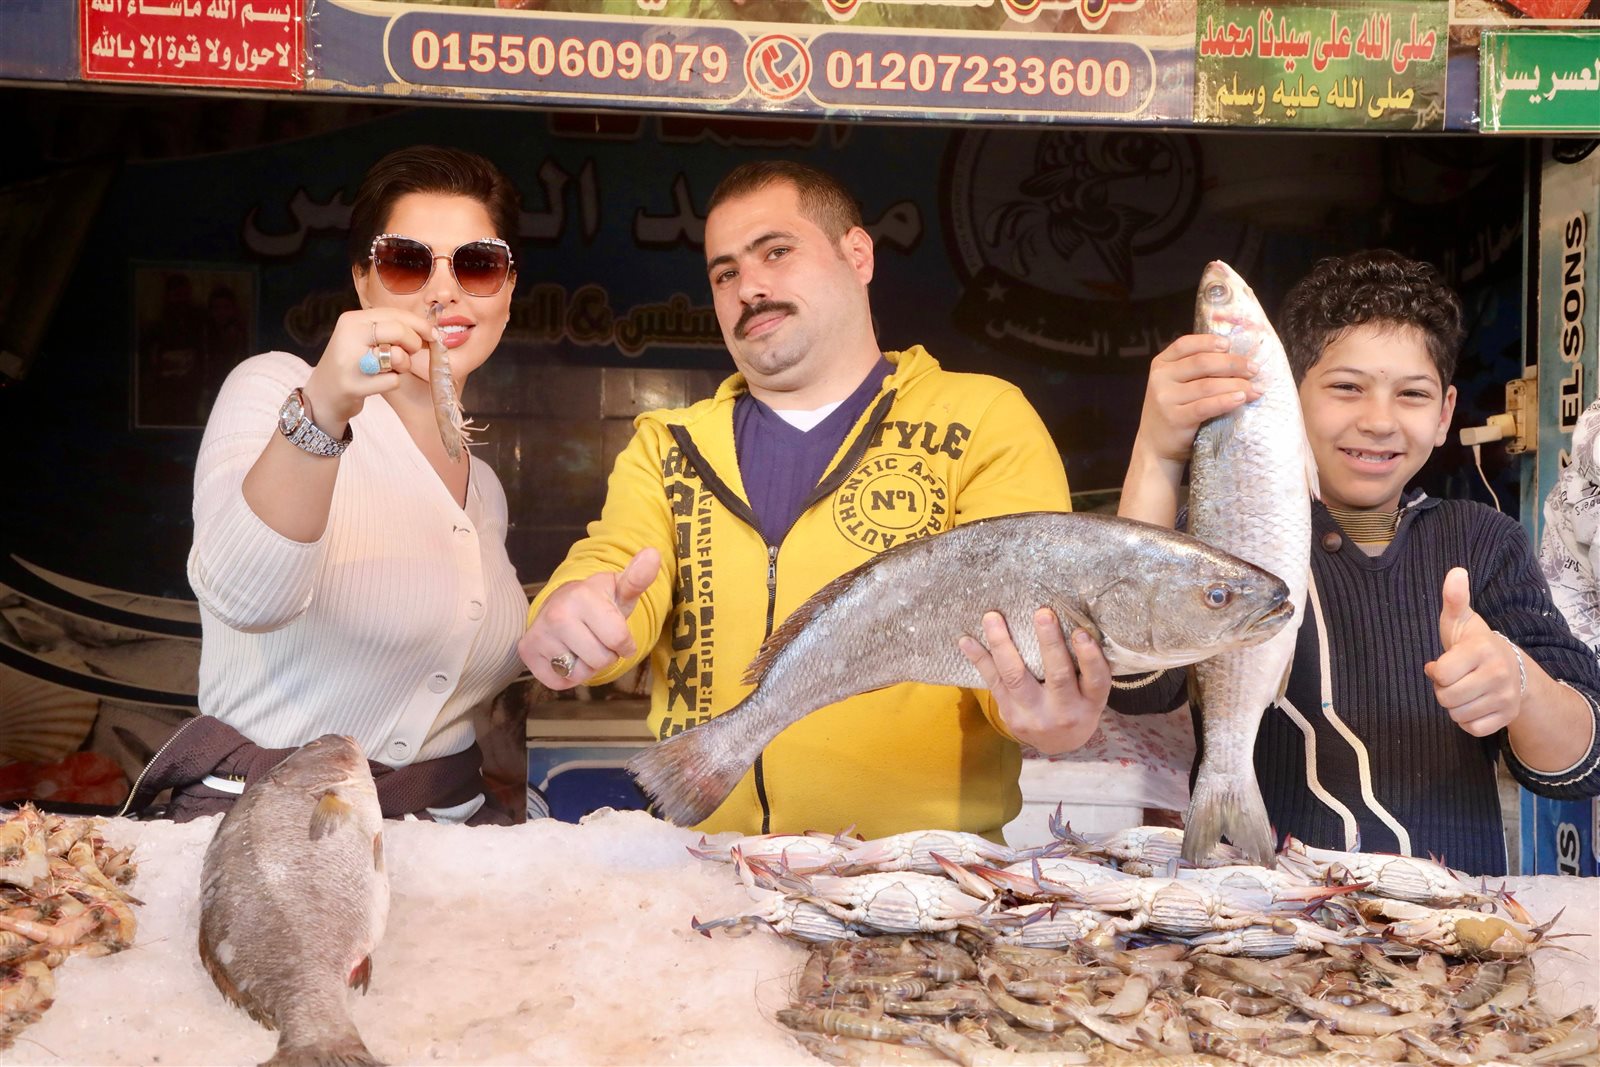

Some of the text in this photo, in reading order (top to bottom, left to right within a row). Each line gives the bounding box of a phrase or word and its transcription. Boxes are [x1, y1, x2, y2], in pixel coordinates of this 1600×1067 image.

[240, 3, 291, 32] بسم
[1200, 15, 1256, 58] محمد
[1257, 8, 1312, 72] سيدنا
[1312, 11, 1353, 72] على
[1355, 12, 1391, 61] الله
[91, 26, 136, 68] بالله
[165, 34, 201, 68] قوة
[205, 36, 231, 70] ولا
[411, 29, 729, 84] 01550609079
[1392, 12, 1437, 74] صلى
[825, 49, 1131, 98] 01207233600
[1215, 71, 1415, 119] صلى الله عليه وسلم
[1563, 216, 1583, 357] SONS
[868, 420, 972, 460] TYLE
[839, 458, 898, 548] AUTHENTIC
[699, 618, 714, 672] FULL
